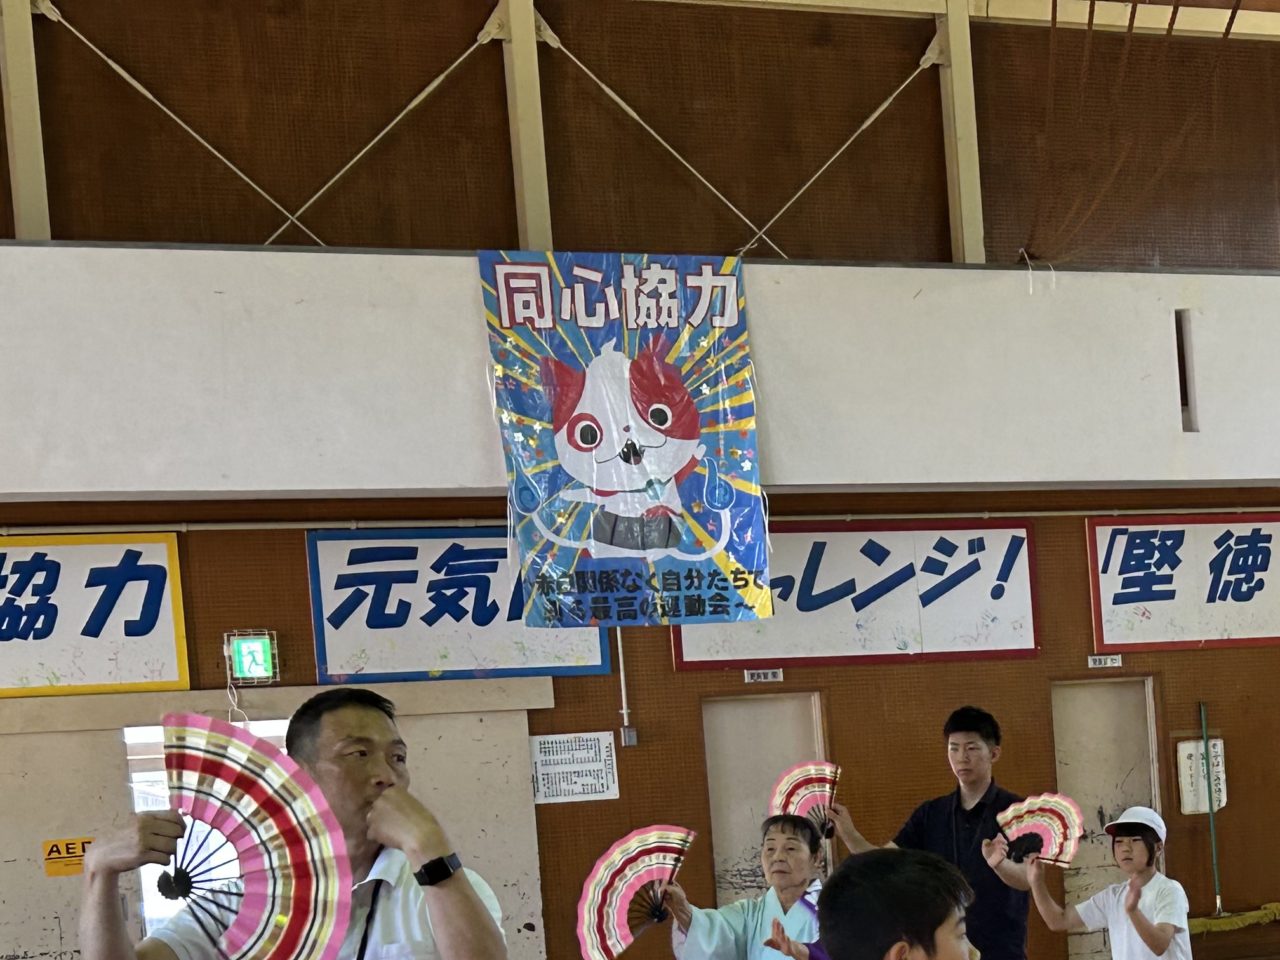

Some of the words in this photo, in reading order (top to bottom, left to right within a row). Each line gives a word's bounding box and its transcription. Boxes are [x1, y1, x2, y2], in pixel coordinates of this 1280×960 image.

[495, 262, 740, 330] 同心協力
[0, 549, 168, 642] 協力
[327, 543, 524, 630] 元気
